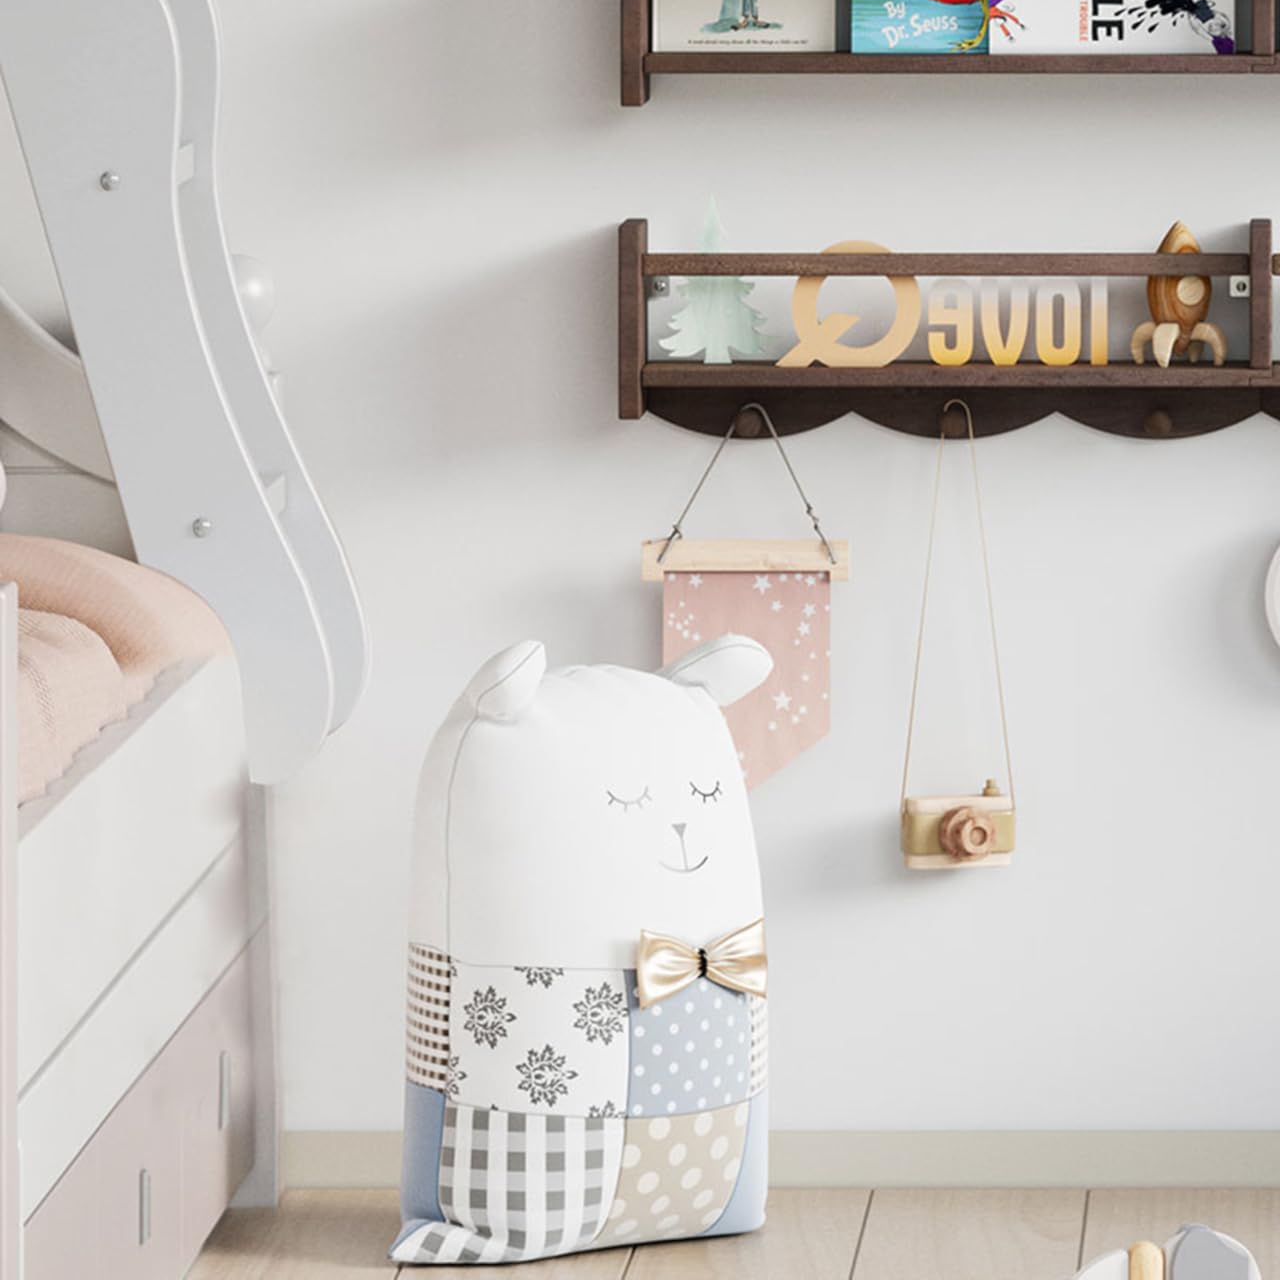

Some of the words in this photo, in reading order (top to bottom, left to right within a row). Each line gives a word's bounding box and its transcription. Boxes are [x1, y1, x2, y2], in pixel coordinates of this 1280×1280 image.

[883, 2, 906, 20] By
[881, 23, 908, 48] Dr.
[910, 7, 959, 39] Seuss
